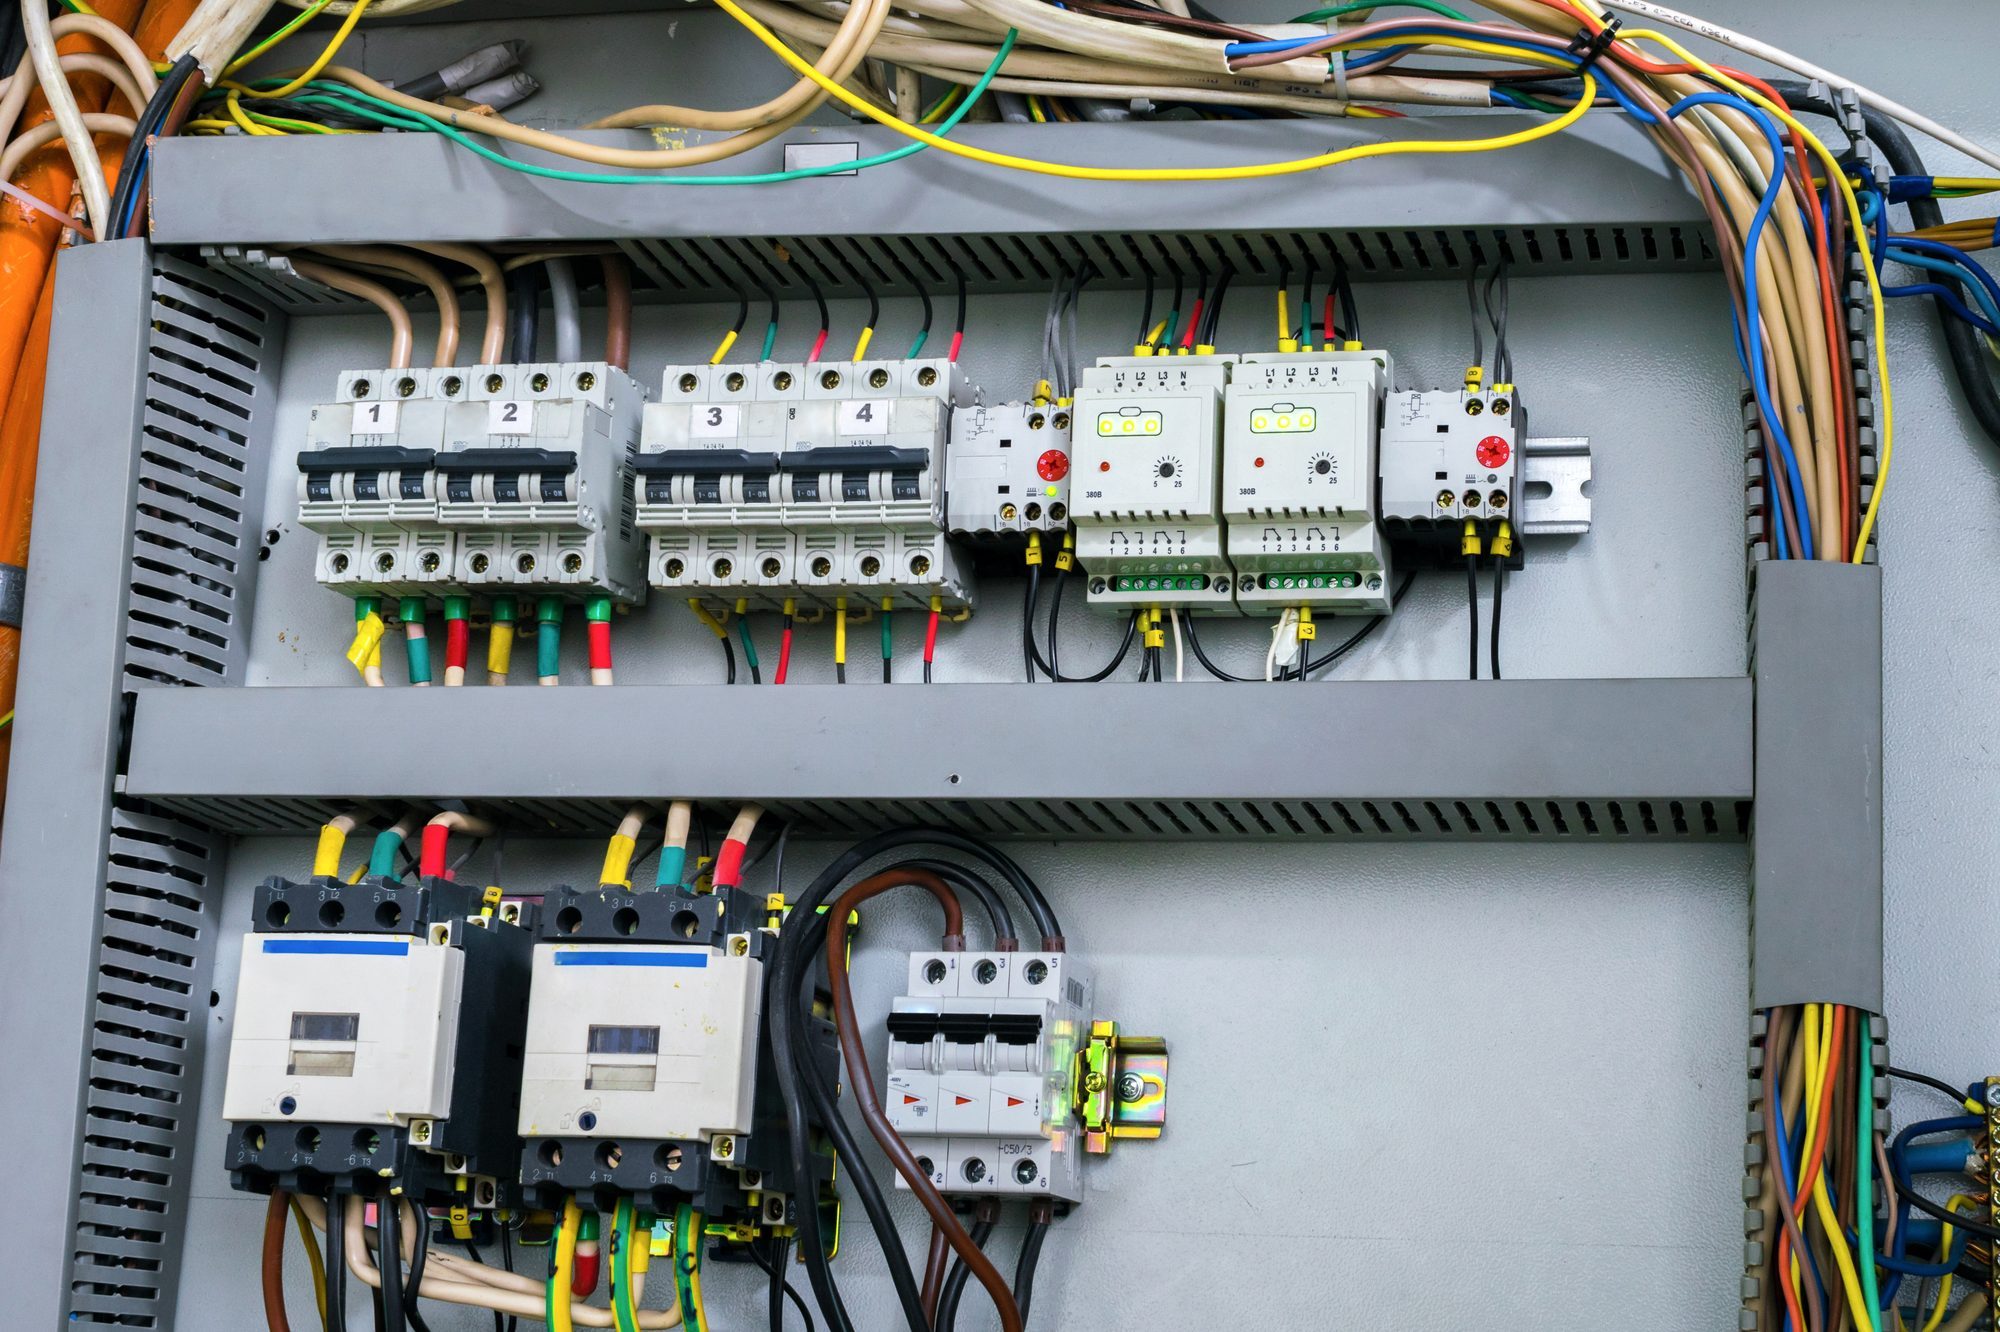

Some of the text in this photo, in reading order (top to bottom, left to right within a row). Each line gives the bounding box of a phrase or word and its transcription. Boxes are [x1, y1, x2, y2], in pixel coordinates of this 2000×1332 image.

[1116, 371, 1187, 380] L1 L2 L3 N
[1266, 367, 1338, 377] L1 L2 L3 N
[369, 404, 380, 422] 1
[502, 403, 518, 422] 2
[707, 407, 722, 426] 3
[856, 403, 873, 423] 4
[1110, 547, 1114, 555] 1
[1124, 547, 1129, 555] 2
[1139, 547, 1143, 555] 3
[1167, 547, 1172, 555] 5
[1262, 544, 1266, 552] 1
[1277, 544, 1282, 552] 2
[1292, 544, 1296, 552] 3
[1334, 543, 1339, 551] 6
[1059, 555, 1068, 563] 5
[319, 891, 325, 901] 3
[374, 892, 380, 903] 5
[612, 898, 619, 909] 3
[669, 901, 676, 912] 5
[684, 902, 693, 910] L3
[951, 958, 1058, 969] 1 3 5
[238, 1151, 245, 1162] 2
[292, 1153, 298, 1164] 4
[304, 1156, 313, 1165] T2
[533, 1169, 540, 1180] 2
[590, 1170, 596, 1181] 4
[603, 1174, 612, 1182] T2
[650, 1172, 657, 1184] 6
[664, 1176, 673, 1184] T3
[936, 1173, 1047, 1188] 2 4 6
[681, 1252, 696, 1276] C
